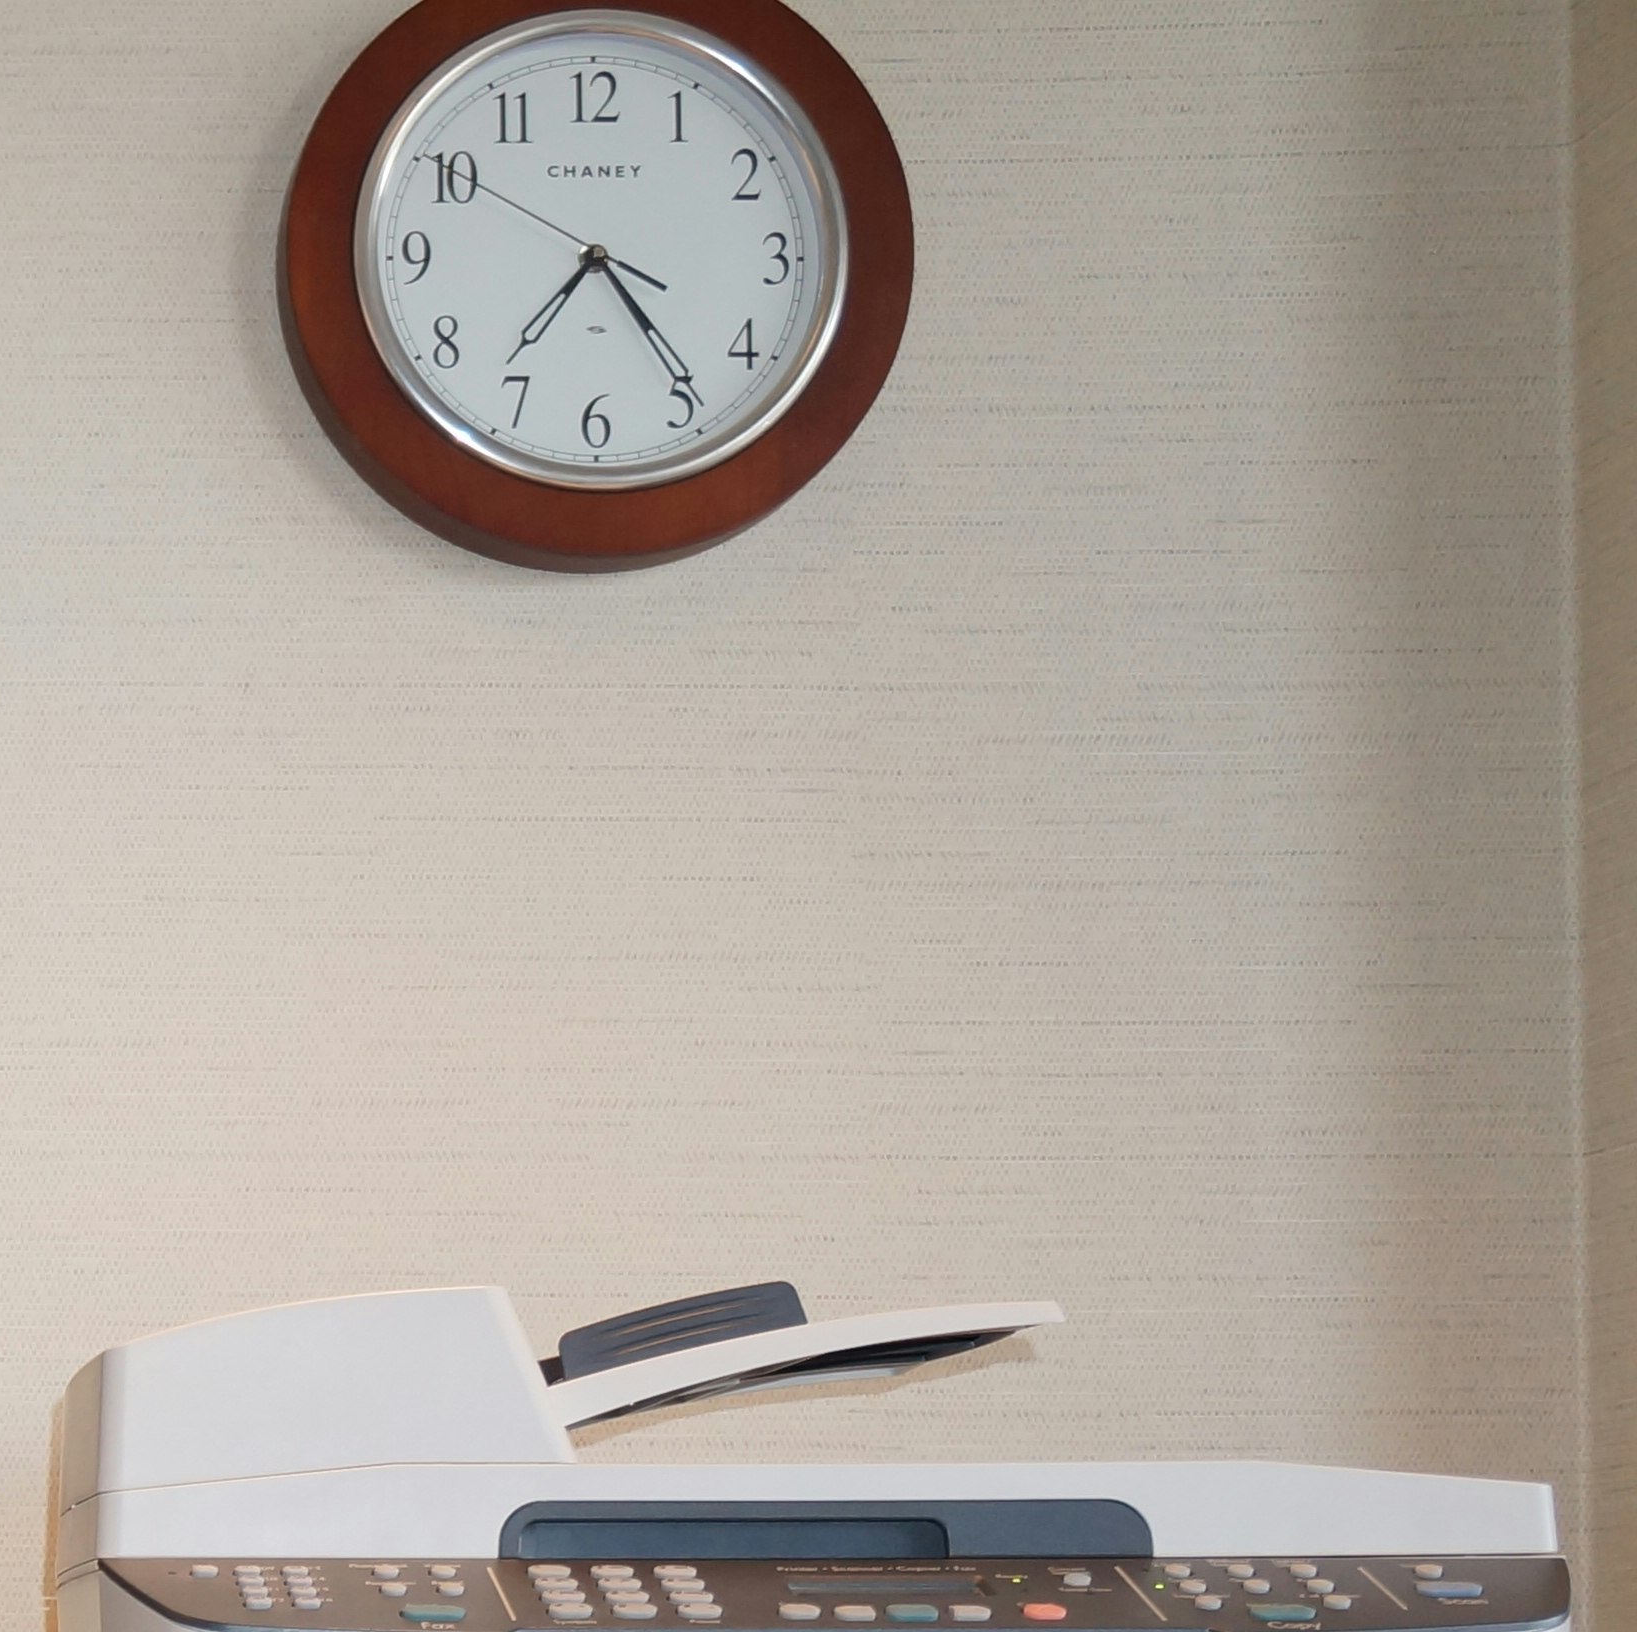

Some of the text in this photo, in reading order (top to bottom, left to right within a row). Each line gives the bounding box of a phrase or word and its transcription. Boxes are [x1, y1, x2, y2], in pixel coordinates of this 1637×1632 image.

[493, 91, 534, 144] 11
[570, 71, 621, 124] 12
[667, 90, 689, 143] 1
[431, 151, 478, 205] 10
[547, 163, 643, 179] CHANEY
[731, 149, 762, 201] 2
[401, 231, 432, 286] 9
[762, 231, 790, 286] 3
[433, 315, 461, 369] 8
[727, 318, 760, 370] 4
[501, 376, 531, 429] 7
[581, 394, 611, 448] 6
[666, 378, 695, 429] 5
